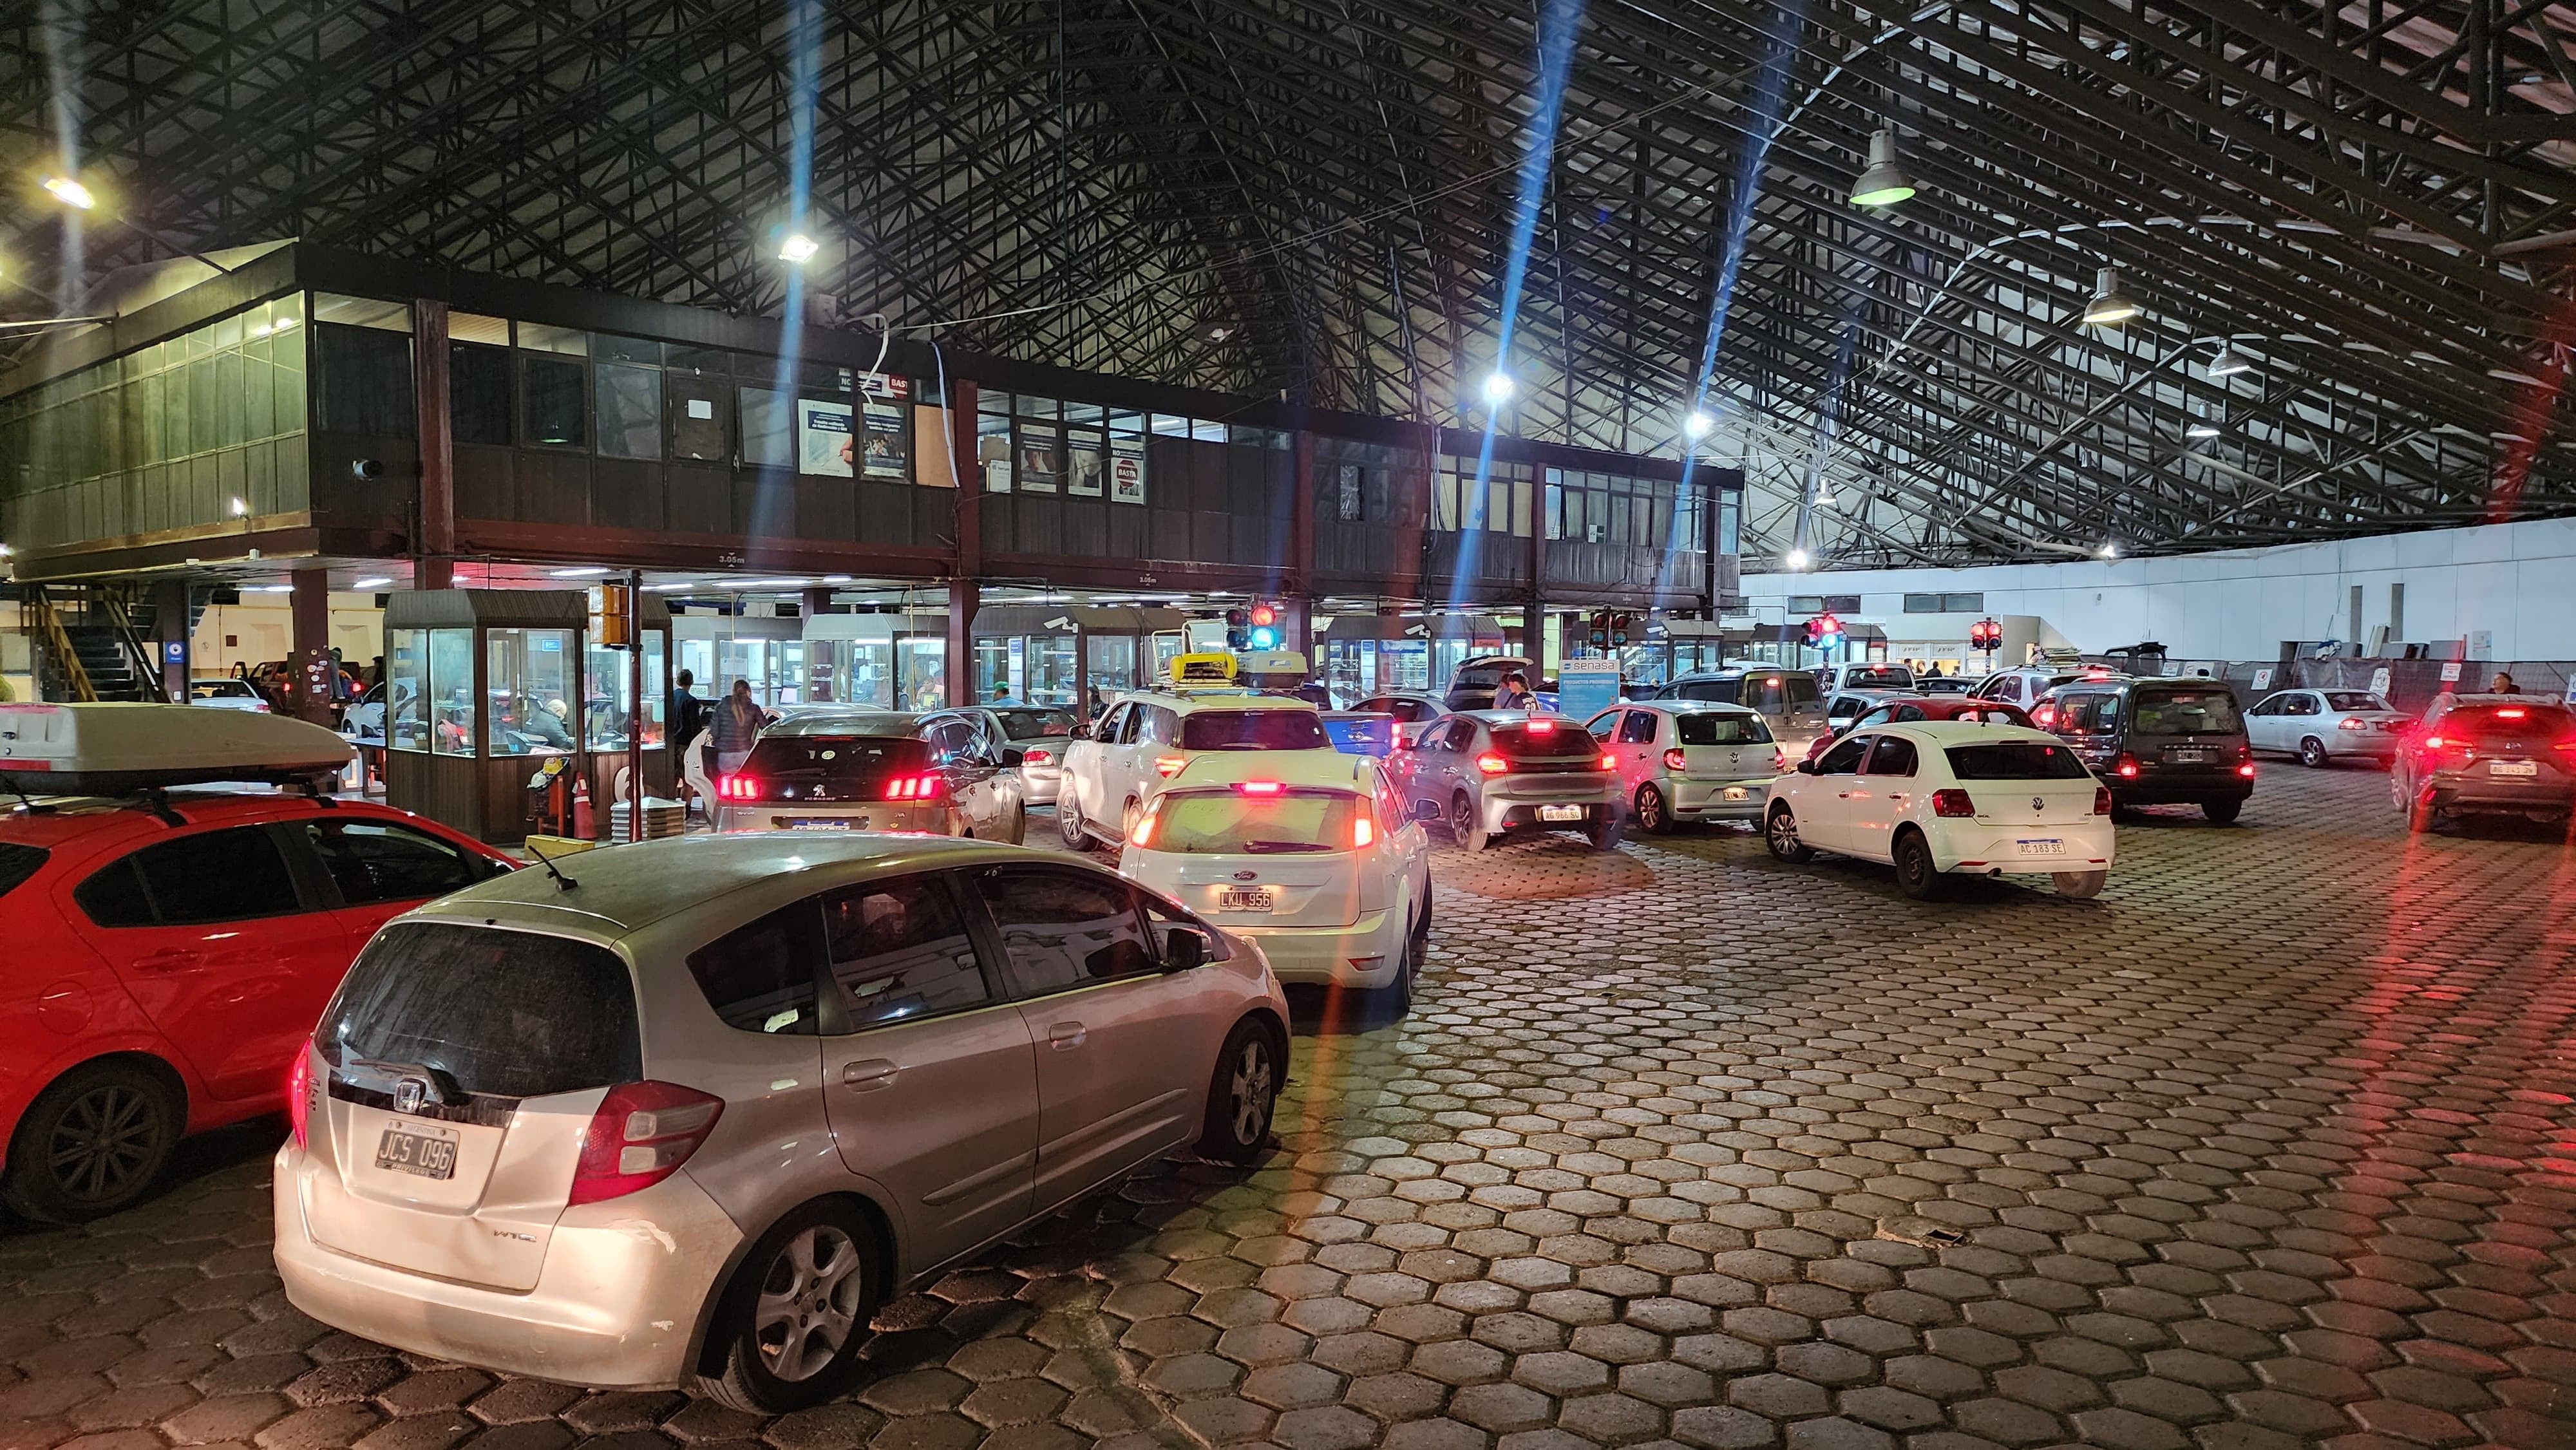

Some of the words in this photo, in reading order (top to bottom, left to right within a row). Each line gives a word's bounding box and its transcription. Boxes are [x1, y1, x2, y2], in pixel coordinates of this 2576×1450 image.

[1118, 469, 1137, 478] BASTA
[719, 556, 744, 564] 3.05m
[1573, 662, 1615, 670] senasa
[2021, 844, 2031, 853] AC
[2033, 844, 2049, 852] 183
[2051, 844, 2063, 852] SE
[1236, 871, 1252, 879] Ford
[1249, 893, 1270, 906] 956
[379, 1132, 413, 1162] JCS
[420, 1138, 453, 1171] 096
